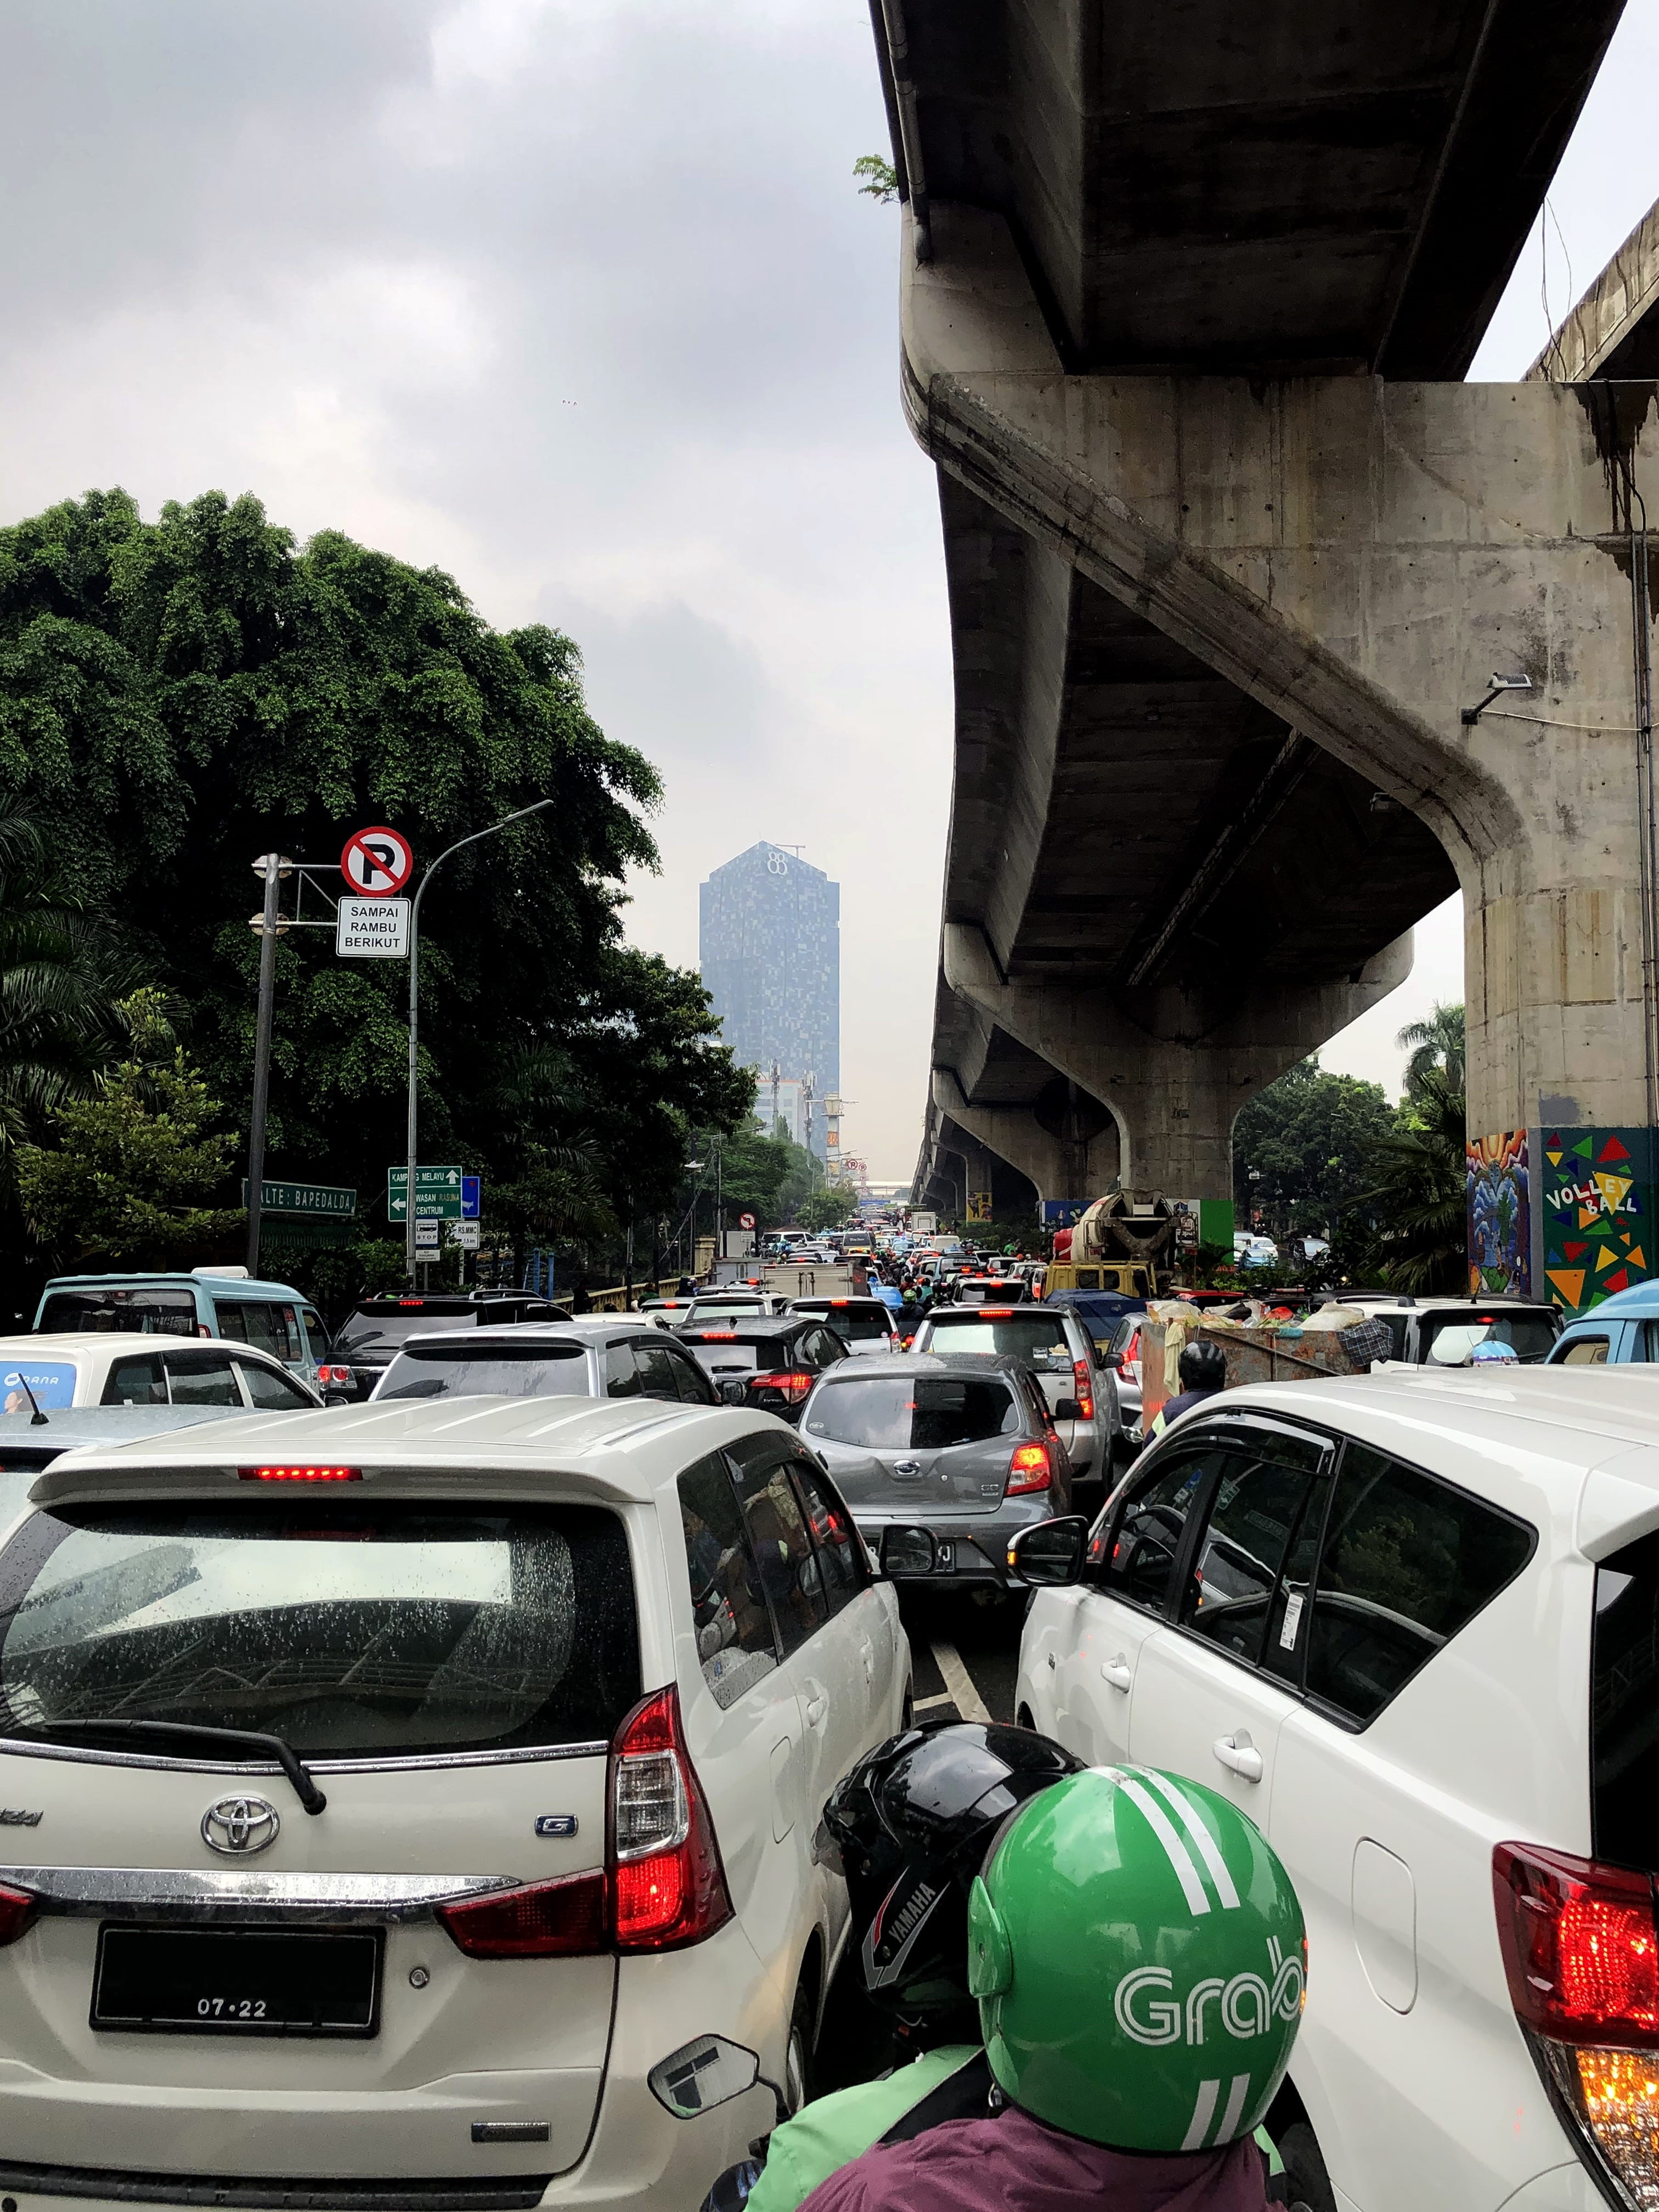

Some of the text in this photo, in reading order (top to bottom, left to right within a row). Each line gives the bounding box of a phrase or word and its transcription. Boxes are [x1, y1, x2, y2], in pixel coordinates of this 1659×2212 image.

[768, 851, 787, 875] 88
[351, 907, 398, 917] SAMPAI
[351, 922, 396, 932] RAMBU
[345, 937, 400, 947] BERIKUT
[392, 1172, 444, 1182] KAMPG MELAYU
[295, 1190, 350, 1209] BAPEDALDA
[416, 1193, 436, 1202] WASAN
[1546, 1179, 1628, 1209] VOLLEY
[416, 1206, 443, 1215] CENTRUM
[1585, 1198, 1637, 1215] BALL
[543, 1818, 570, 1832] G
[888, 1882, 936, 1943] YAMAHA
[1114, 1934, 1305, 2046] Grab
